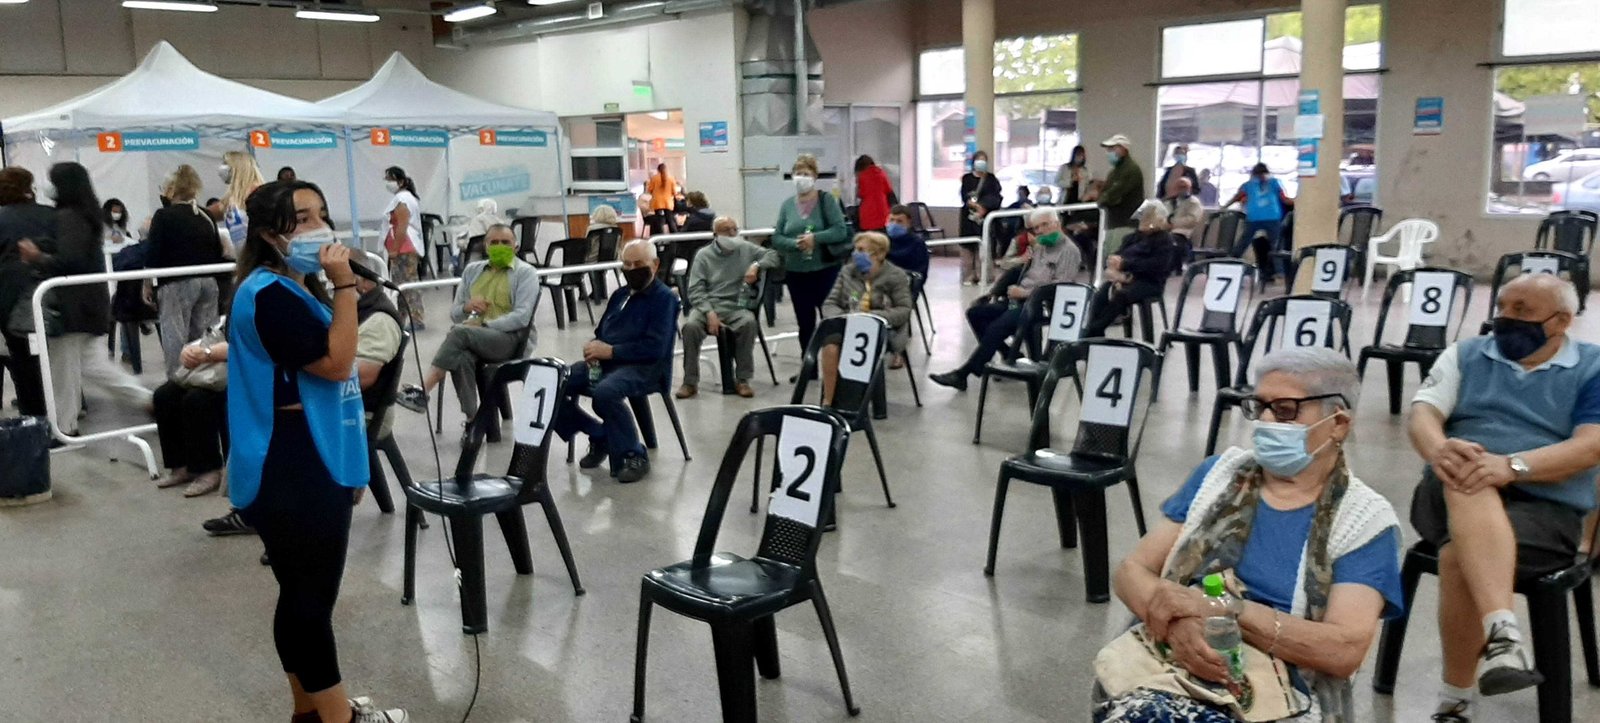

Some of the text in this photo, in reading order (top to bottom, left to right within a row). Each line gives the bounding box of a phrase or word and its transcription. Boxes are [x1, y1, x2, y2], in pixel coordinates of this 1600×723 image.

[105, 135, 195, 149] 2 PREVACUNACIÓN
[256, 132, 266, 145] 2
[376, 131, 385, 143] 2
[483, 132, 492, 144] 2
[1321, 260, 1337, 283] 9
[1216, 276, 1233, 301] 7
[1421, 286, 1442, 314] 8
[1060, 300, 1077, 329] 5
[1295, 316, 1318, 347] 6
[849, 332, 870, 367] 3
[1095, 367, 1123, 408] 4
[529, 387, 546, 430] 1
[785, 445, 817, 503] 2
